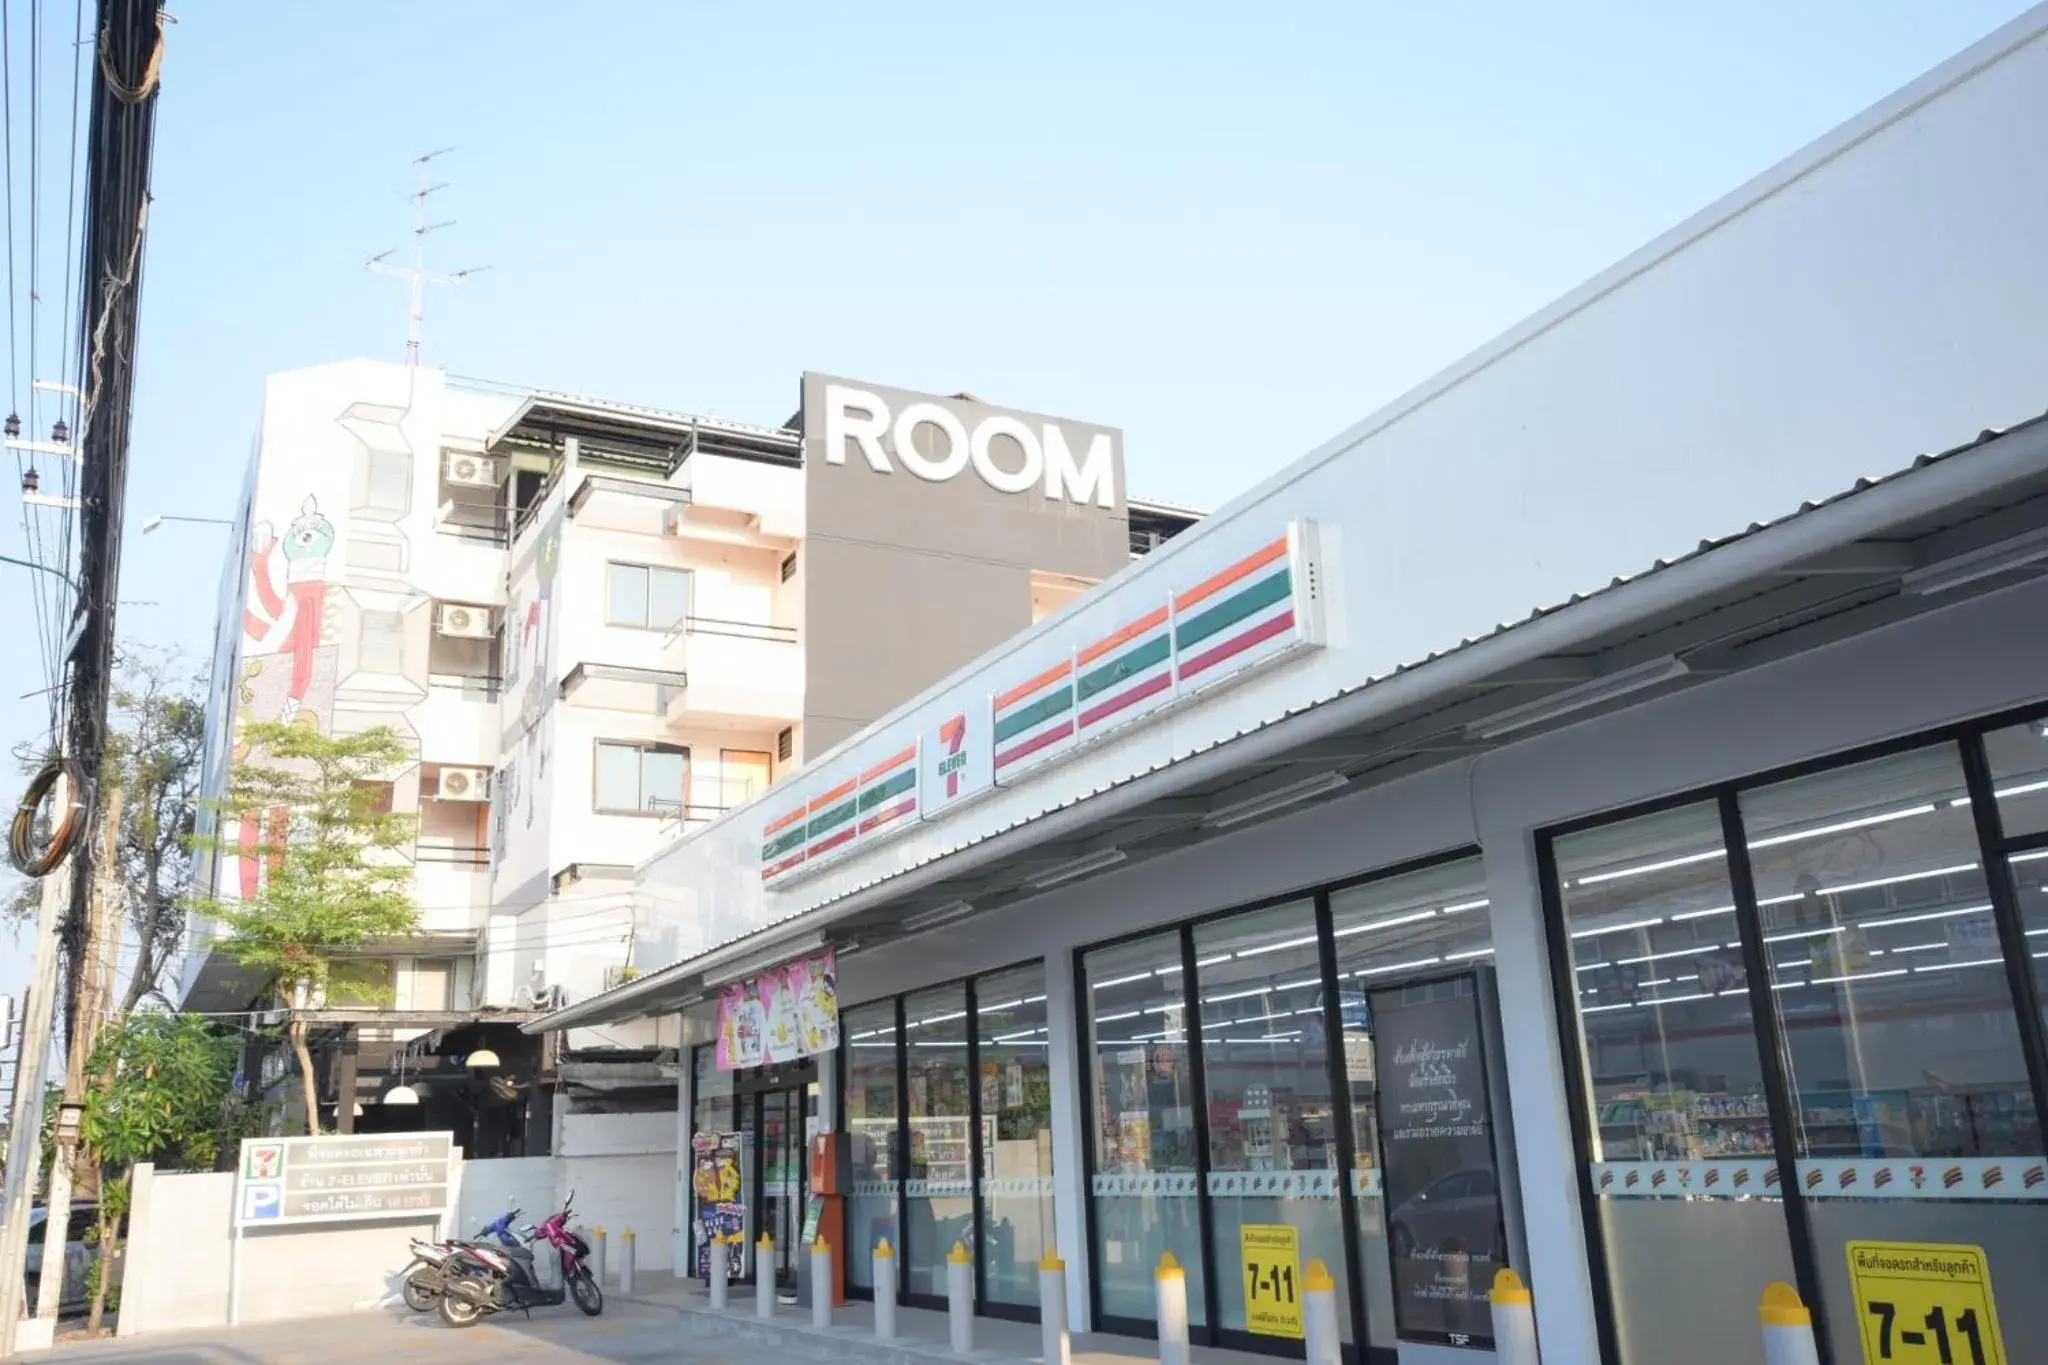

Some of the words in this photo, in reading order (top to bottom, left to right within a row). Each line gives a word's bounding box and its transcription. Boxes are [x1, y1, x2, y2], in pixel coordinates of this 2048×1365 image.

[825, 384, 1116, 510] ROOM
[244, 1186, 279, 1219] P
[1248, 1263, 1294, 1303] 7-11
[1868, 1301, 1988, 1365] 7-11
